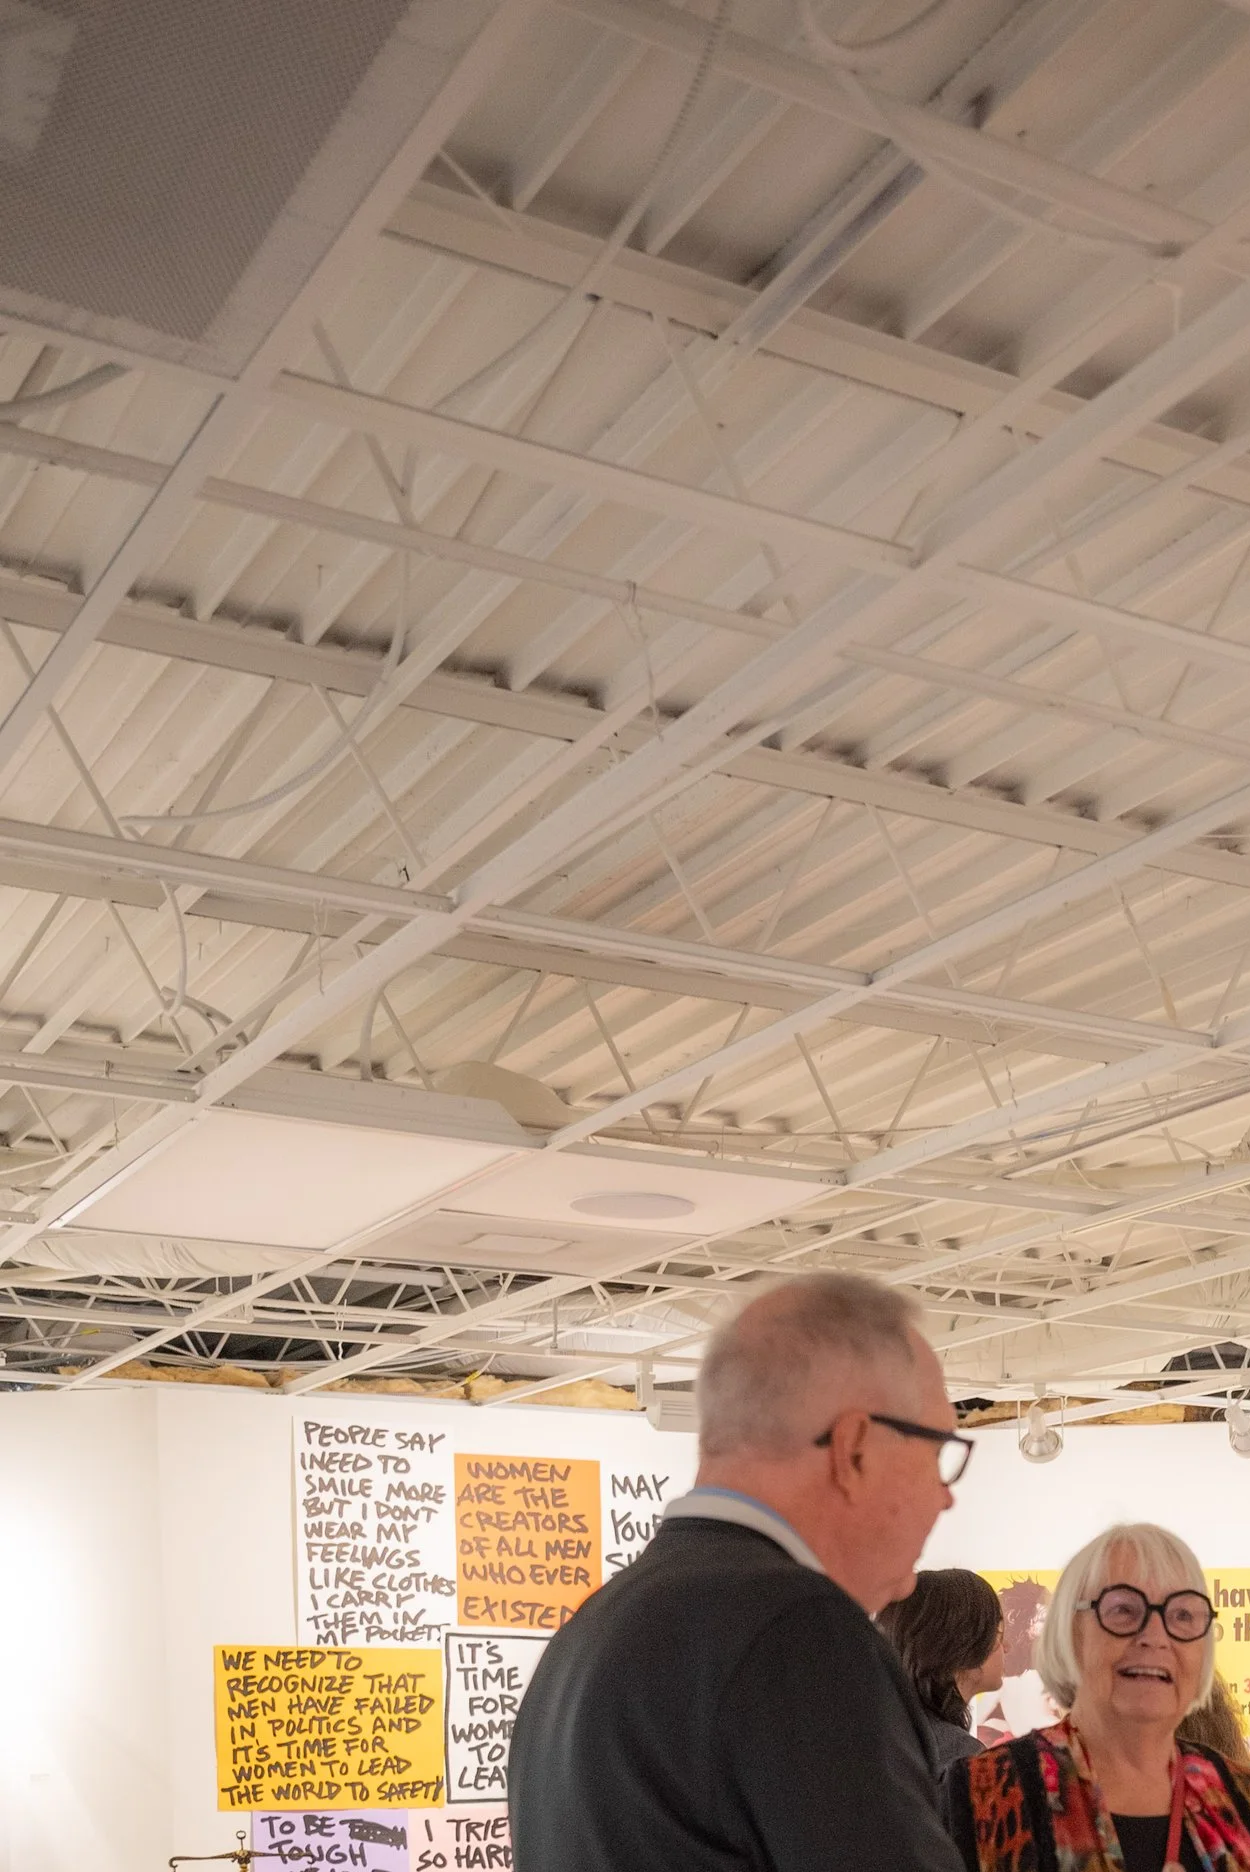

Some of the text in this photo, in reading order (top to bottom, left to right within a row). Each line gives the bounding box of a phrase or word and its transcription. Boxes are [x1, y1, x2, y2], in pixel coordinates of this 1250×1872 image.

[303, 1420, 446, 1454] PEOPLE SAY
[377, 1454, 411, 1474] TO
[466, 1461, 572, 1483] WOMEN
[304, 1474, 447, 1505] SMILE MORE
[456, 1483, 570, 1509] ARE THE
[611, 1474, 670, 1502] MAY
[302, 1496, 439, 1524] BUT I DONT
[459, 1511, 589, 1534] CREATORS
[304, 1520, 418, 1543] WEAR MY
[459, 1536, 492, 1560] OF
[496, 1535, 538, 1558] ALL
[545, 1539, 592, 1561] MEN
[309, 1566, 457, 1597] LIKE CLOTHES
[462, 1562, 592, 1588] WHO EVER
[310, 1590, 415, 1611] I CARRY
[306, 1608, 427, 1630] THEM IN
[221, 1650, 363, 1671] WE NEED TO
[226, 1672, 426, 1702] RECOGNIZE THAT
[456, 1666, 523, 1691] TIME
[227, 1693, 436, 1722] MEN HAVE FAILED
[468, 1694, 518, 1716] FOR
[230, 1715, 423, 1744] IN POLITICS AND
[232, 1736, 389, 1765] IT'S TIME FOR
[468, 1742, 506, 1765] TO
[232, 1755, 413, 1784] WOMEN TO LEAD
[458, 1765, 508, 1791] LEA
[221, 1776, 444, 1807] THE WORLD TO SAFETY
[260, 1815, 296, 1839] TO
[303, 1814, 336, 1838] BE
[424, 1819, 433, 1842] I
[446, 1817, 508, 1842] TRIE
[268, 1839, 367, 1867] TOUGH
[416, 1849, 448, 1872] SO
